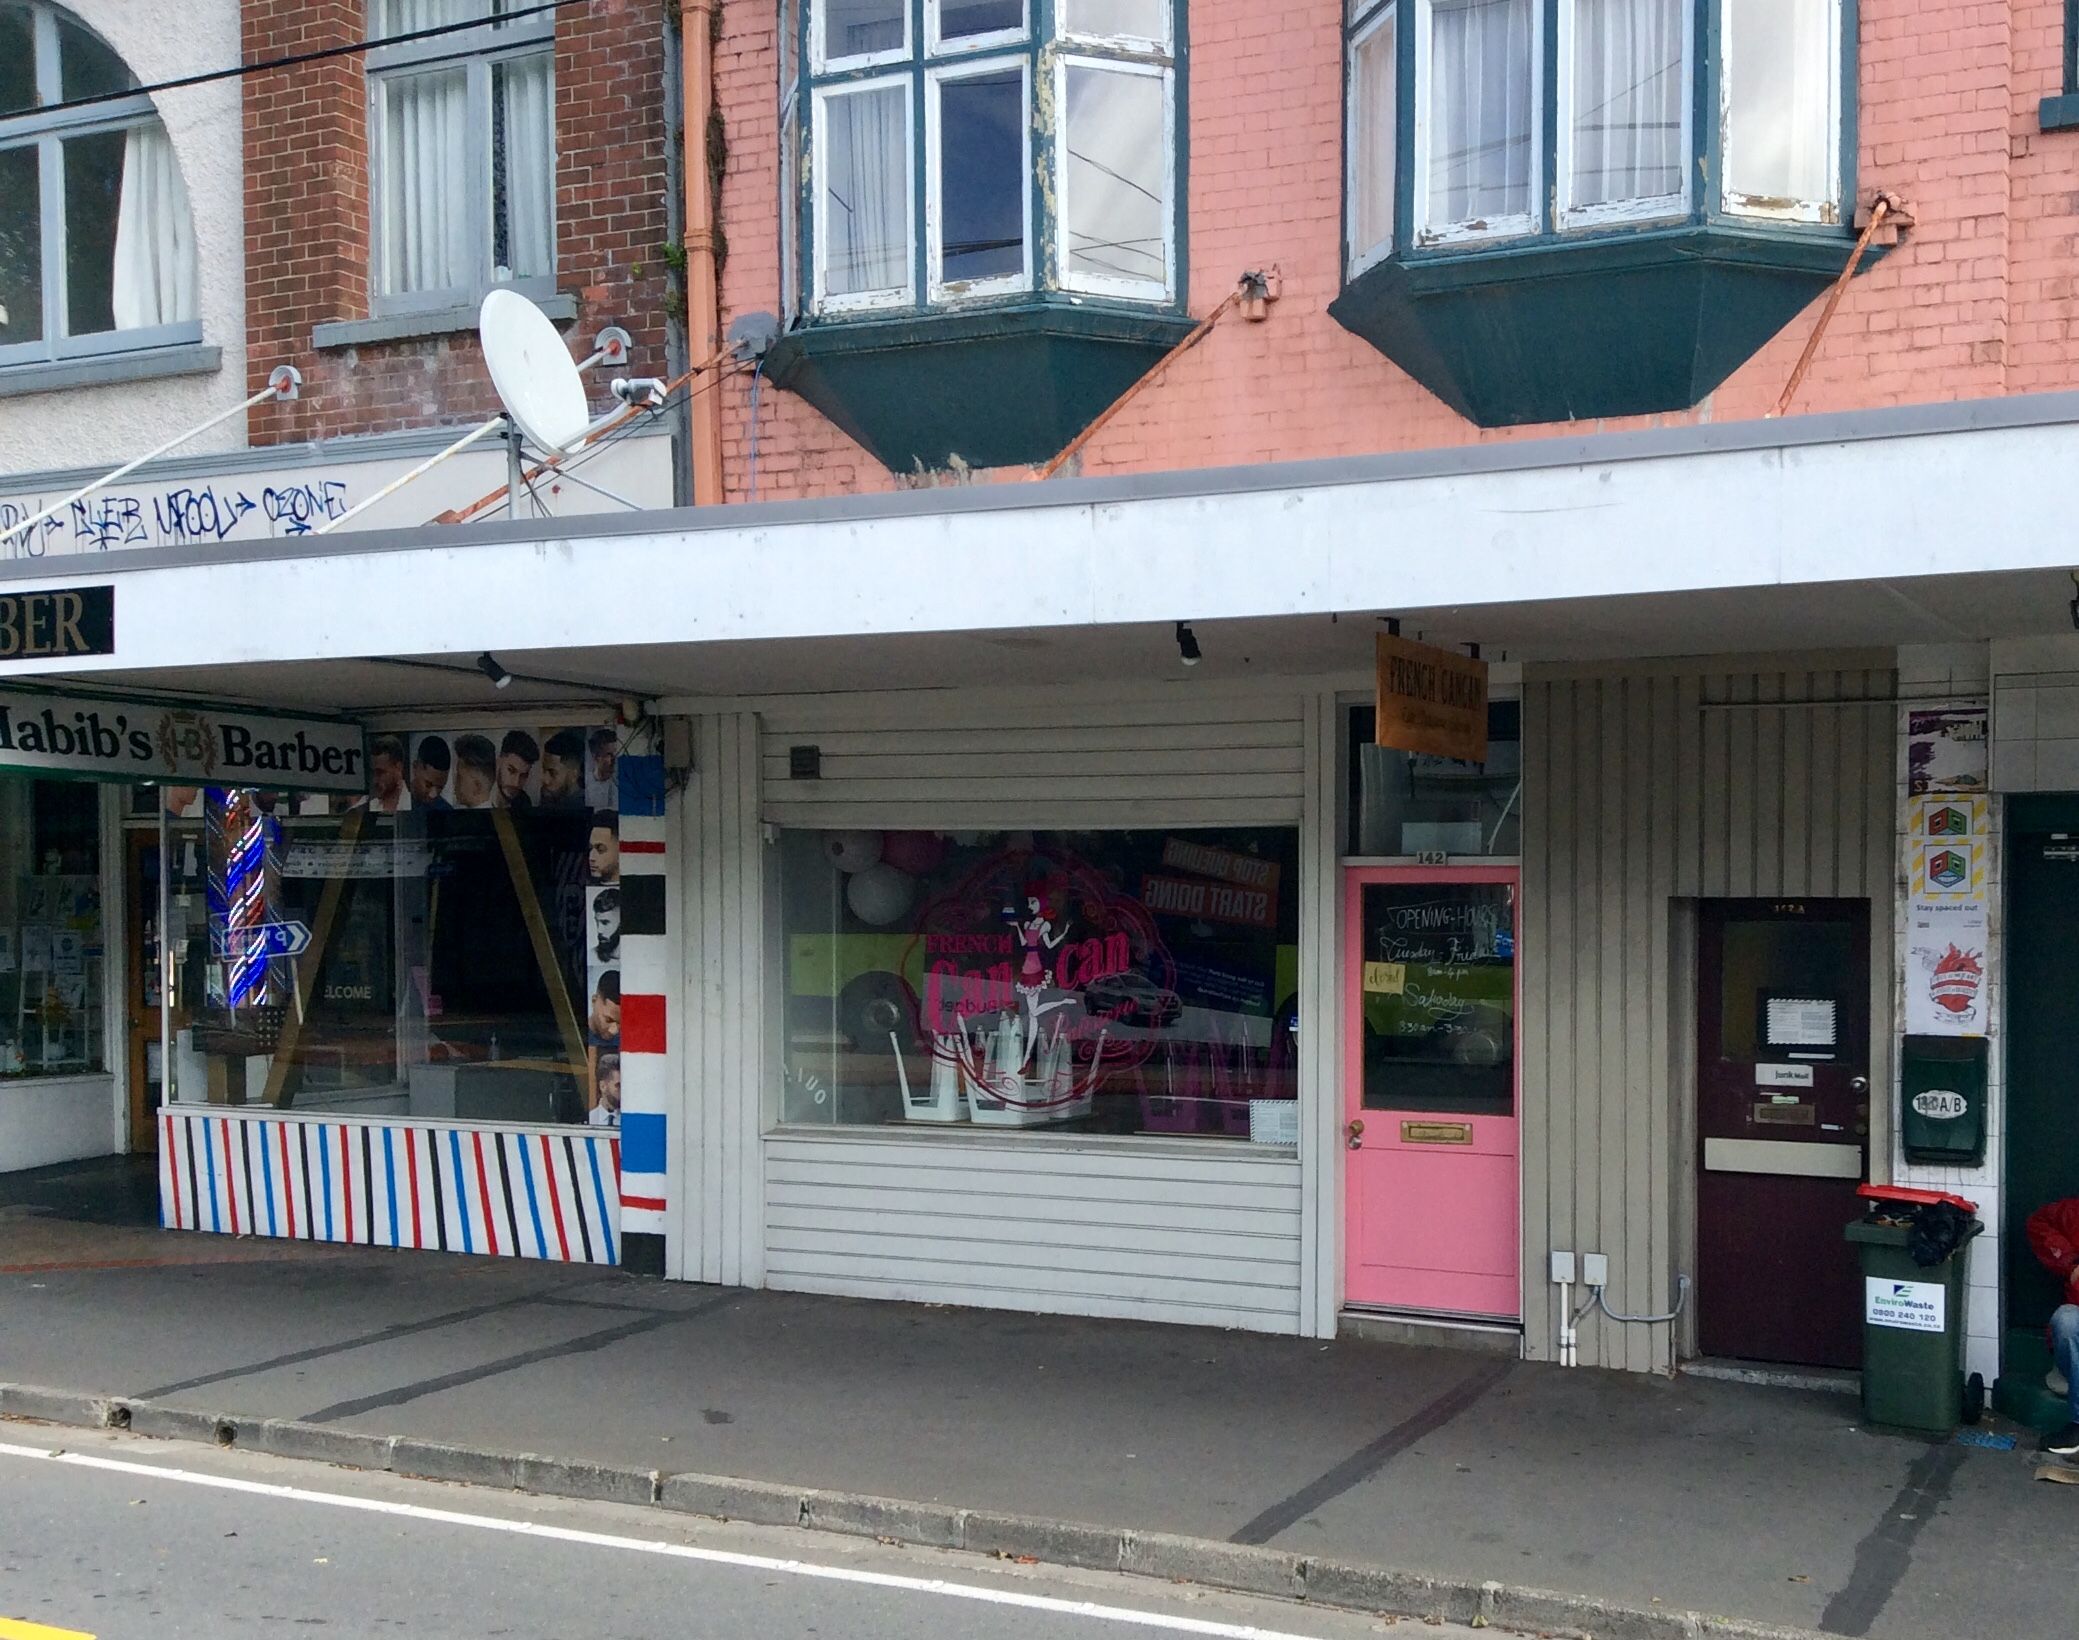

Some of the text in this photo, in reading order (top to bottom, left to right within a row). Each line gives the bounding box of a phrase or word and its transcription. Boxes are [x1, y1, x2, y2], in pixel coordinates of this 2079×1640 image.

[1390, 656, 1435, 702] FRENCH
[219, 724, 362, 776] Barber
[1418, 852, 1444, 864] 142
[1916, 904, 1933, 912] Stay
[1935, 904, 1962, 912] spaced
[927, 933, 1013, 954] FRENCH
[1874, 1296, 1934, 1310] EnviroWaste
[1873, 1309, 1895, 1317] 0800
[1898, 1311, 1915, 1320] 240
